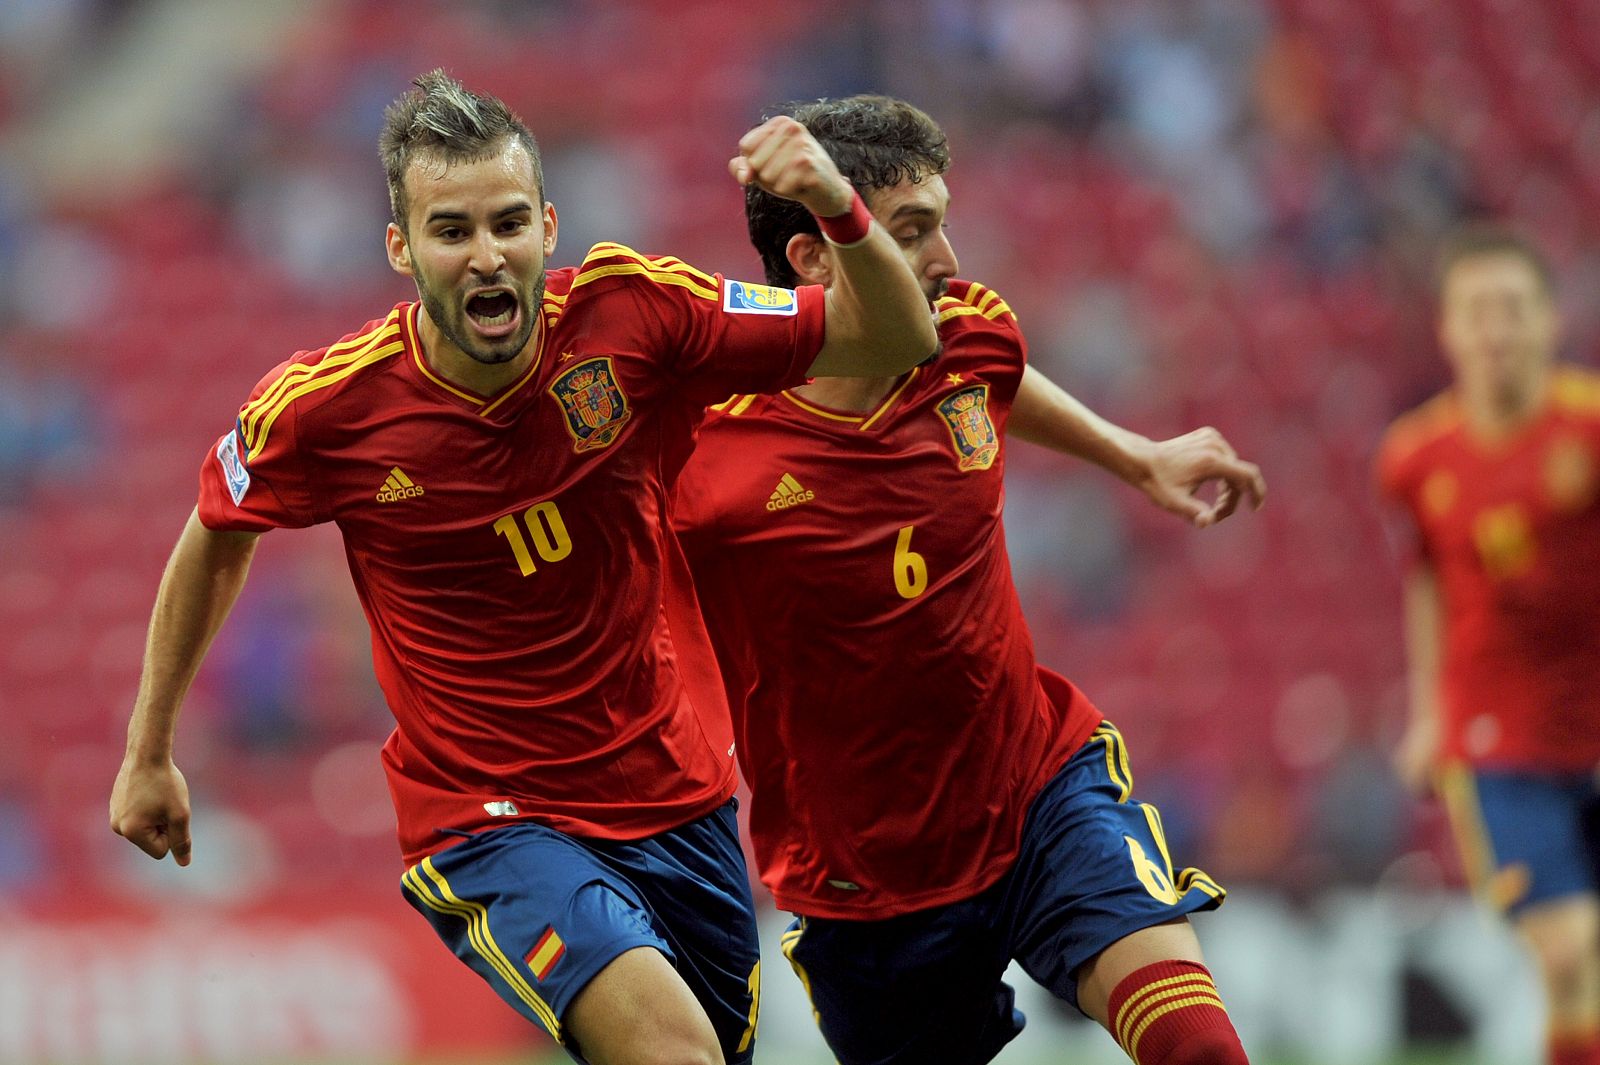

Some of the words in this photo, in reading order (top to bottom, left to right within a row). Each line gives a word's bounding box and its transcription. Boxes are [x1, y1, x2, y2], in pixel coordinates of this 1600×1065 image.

[376, 484, 424, 502] adidas
[766, 489, 815, 511] adidas
[493, 501, 573, 577] 10
[893, 525, 928, 599] 6
[1124, 836, 1178, 906] 6
